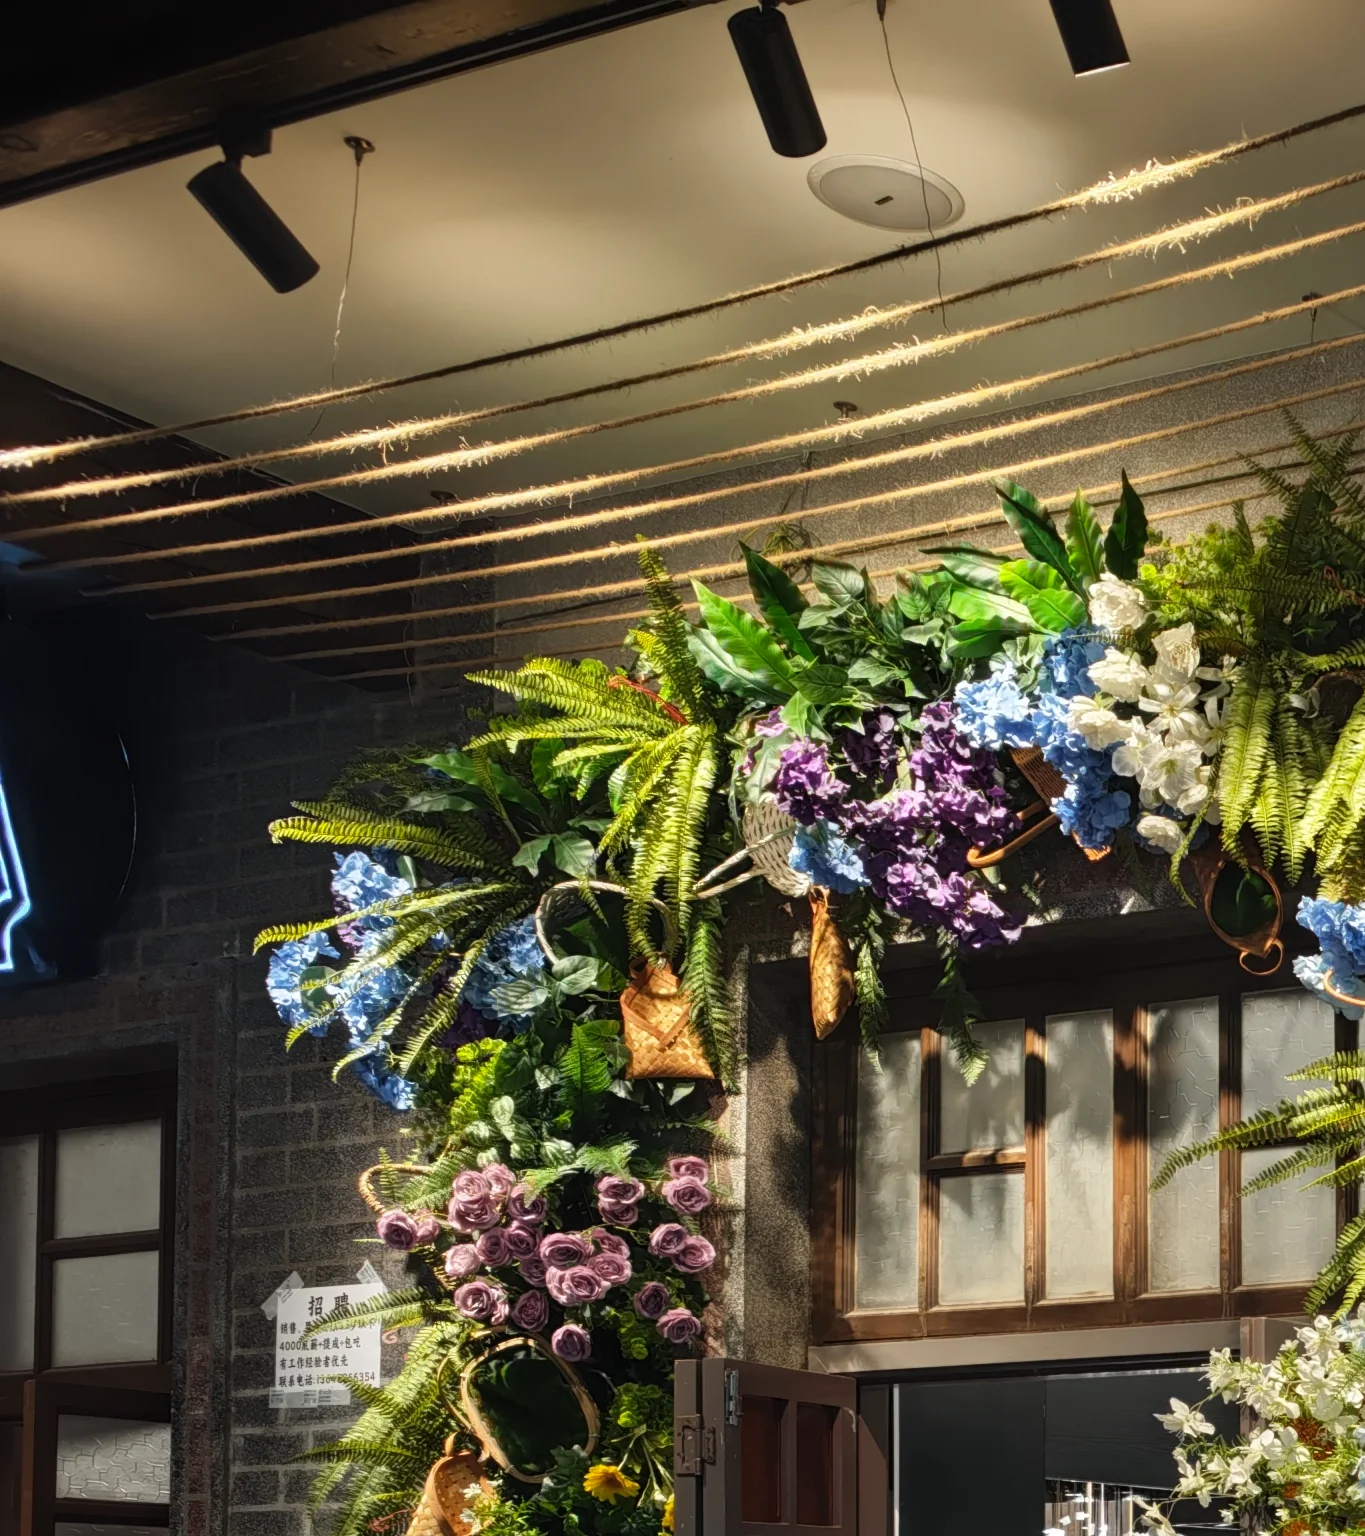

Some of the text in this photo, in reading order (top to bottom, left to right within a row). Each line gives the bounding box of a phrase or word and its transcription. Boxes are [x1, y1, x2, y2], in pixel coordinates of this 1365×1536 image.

[308, 1292, 350, 1316] 招聘
[280, 1354, 349, 1370] 有工作经验者优先
